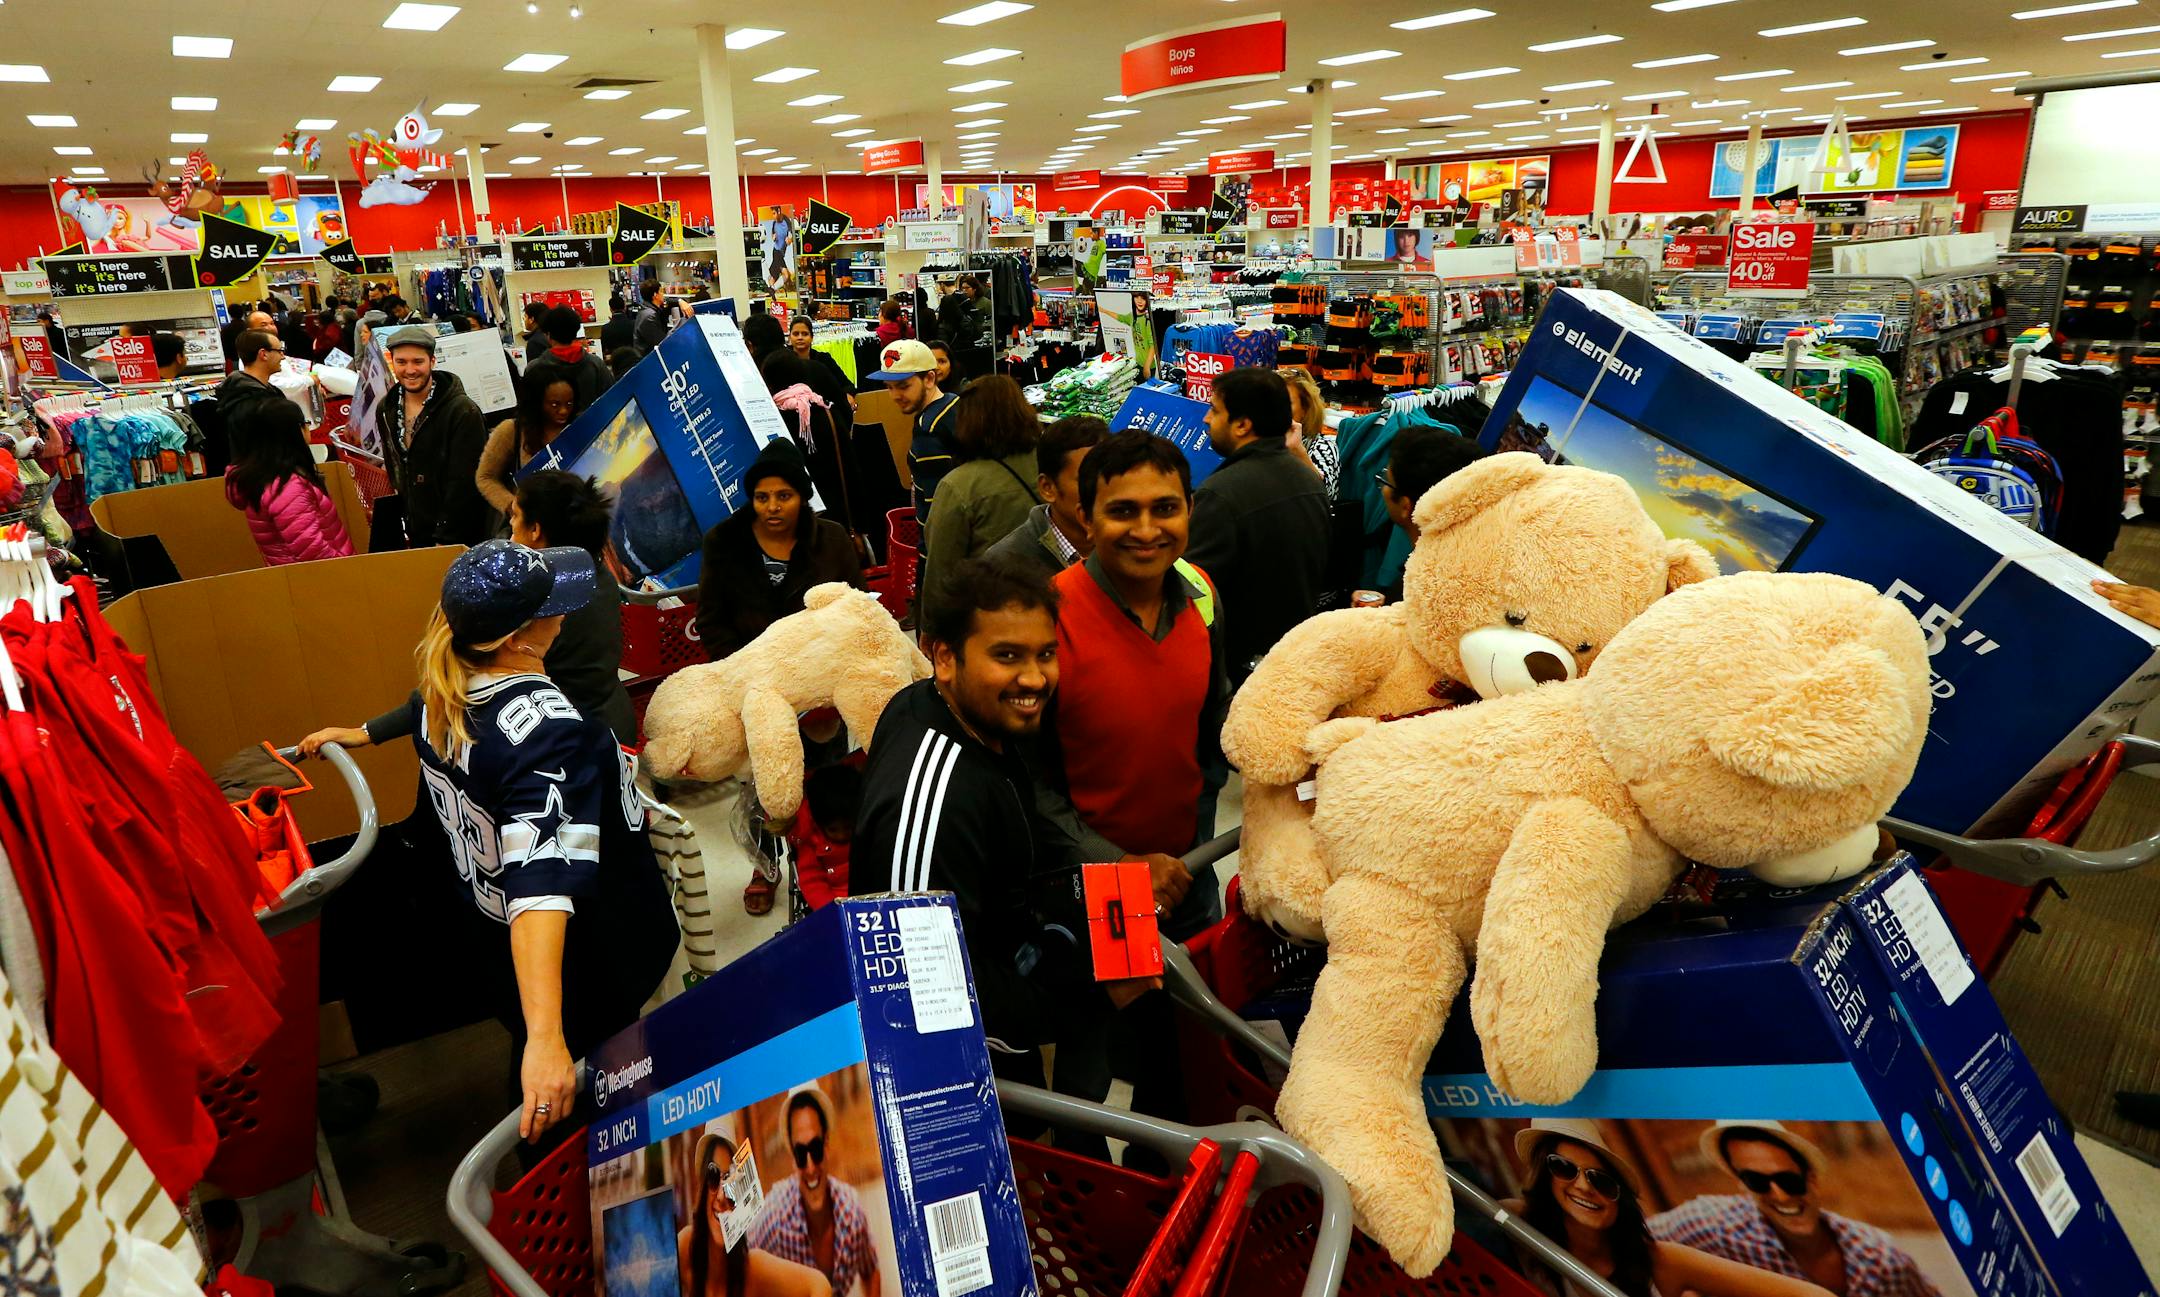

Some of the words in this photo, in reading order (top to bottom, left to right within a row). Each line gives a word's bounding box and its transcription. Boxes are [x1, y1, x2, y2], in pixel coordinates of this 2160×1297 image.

[1169, 48, 1196, 62] Boys
[1170, 64, 1194, 76] Niños
[1212, 210, 1230, 219] SALE
[1386, 208, 1398, 216] SALE
[1456, 207, 1468, 215] SALE
[2021, 210, 2073, 224] AURO
[620, 230, 655, 241] SALE
[810, 224, 839, 234] SALE
[1512, 228, 1529, 242] Sale
[1557, 228, 1574, 241] Sale
[1735, 226, 1796, 248] Sale
[210, 244, 259, 259] SALE
[548, 242, 568, 250] here
[1668, 244, 1690, 253] Sale
[330, 254, 354, 263] SALE
[544, 251, 557, 259] it's
[559, 250, 578, 258] here
[1135, 257, 1148, 265] Sale
[78, 263, 97, 273] it's
[99, 262, 129, 271] here
[530, 260, 544, 268] it's
[545, 259, 565, 267] here
[95, 272, 114, 282] it's
[118, 271, 146, 280] here
[1153, 274, 1170, 284] Sale
[1762, 272, 1775, 280] off
[15, 280, 33, 289] top
[36, 279, 49, 289] gif
[76, 284, 95, 293] it's
[99, 283, 128, 292] here
[772, 302, 784, 315] Sale
[22, 338, 43, 351] Sale
[112, 339, 144, 355] Sale
[1187, 353, 1224, 375] Sale
[1564, 328, 1643, 386] element
[660, 360, 690, 402] 50"
[686, 384, 699, 400] LED
[496, 688, 583, 746] 82
[420, 758, 504, 926] 82
[1073, 873, 1081, 899] solo
[1863, 898, 1885, 925] 32
[856, 911, 884, 933] 32
[1875, 914, 1905, 947] LED
[860, 932, 904, 956] LED
[1813, 959, 1832, 987] 32
[1824, 927, 1852, 972] INCH
[1887, 936, 1913, 969] HD
[864, 955, 908, 980] HDT
[870, 984, 887, 994] 31.5"
[888, 982, 910, 992] DIAGO
[1826, 973, 1849, 1012] LED
[1839, 984, 1867, 1035] HDTV
[607, 1056, 653, 1094] Westinghouse
[662, 1095, 685, 1126] LED
[688, 1077, 721, 1115] HDTV
[1428, 1086, 1480, 1107] LED
[597, 1130, 609, 1153] 32
[612, 1116, 637, 1147] INCH
